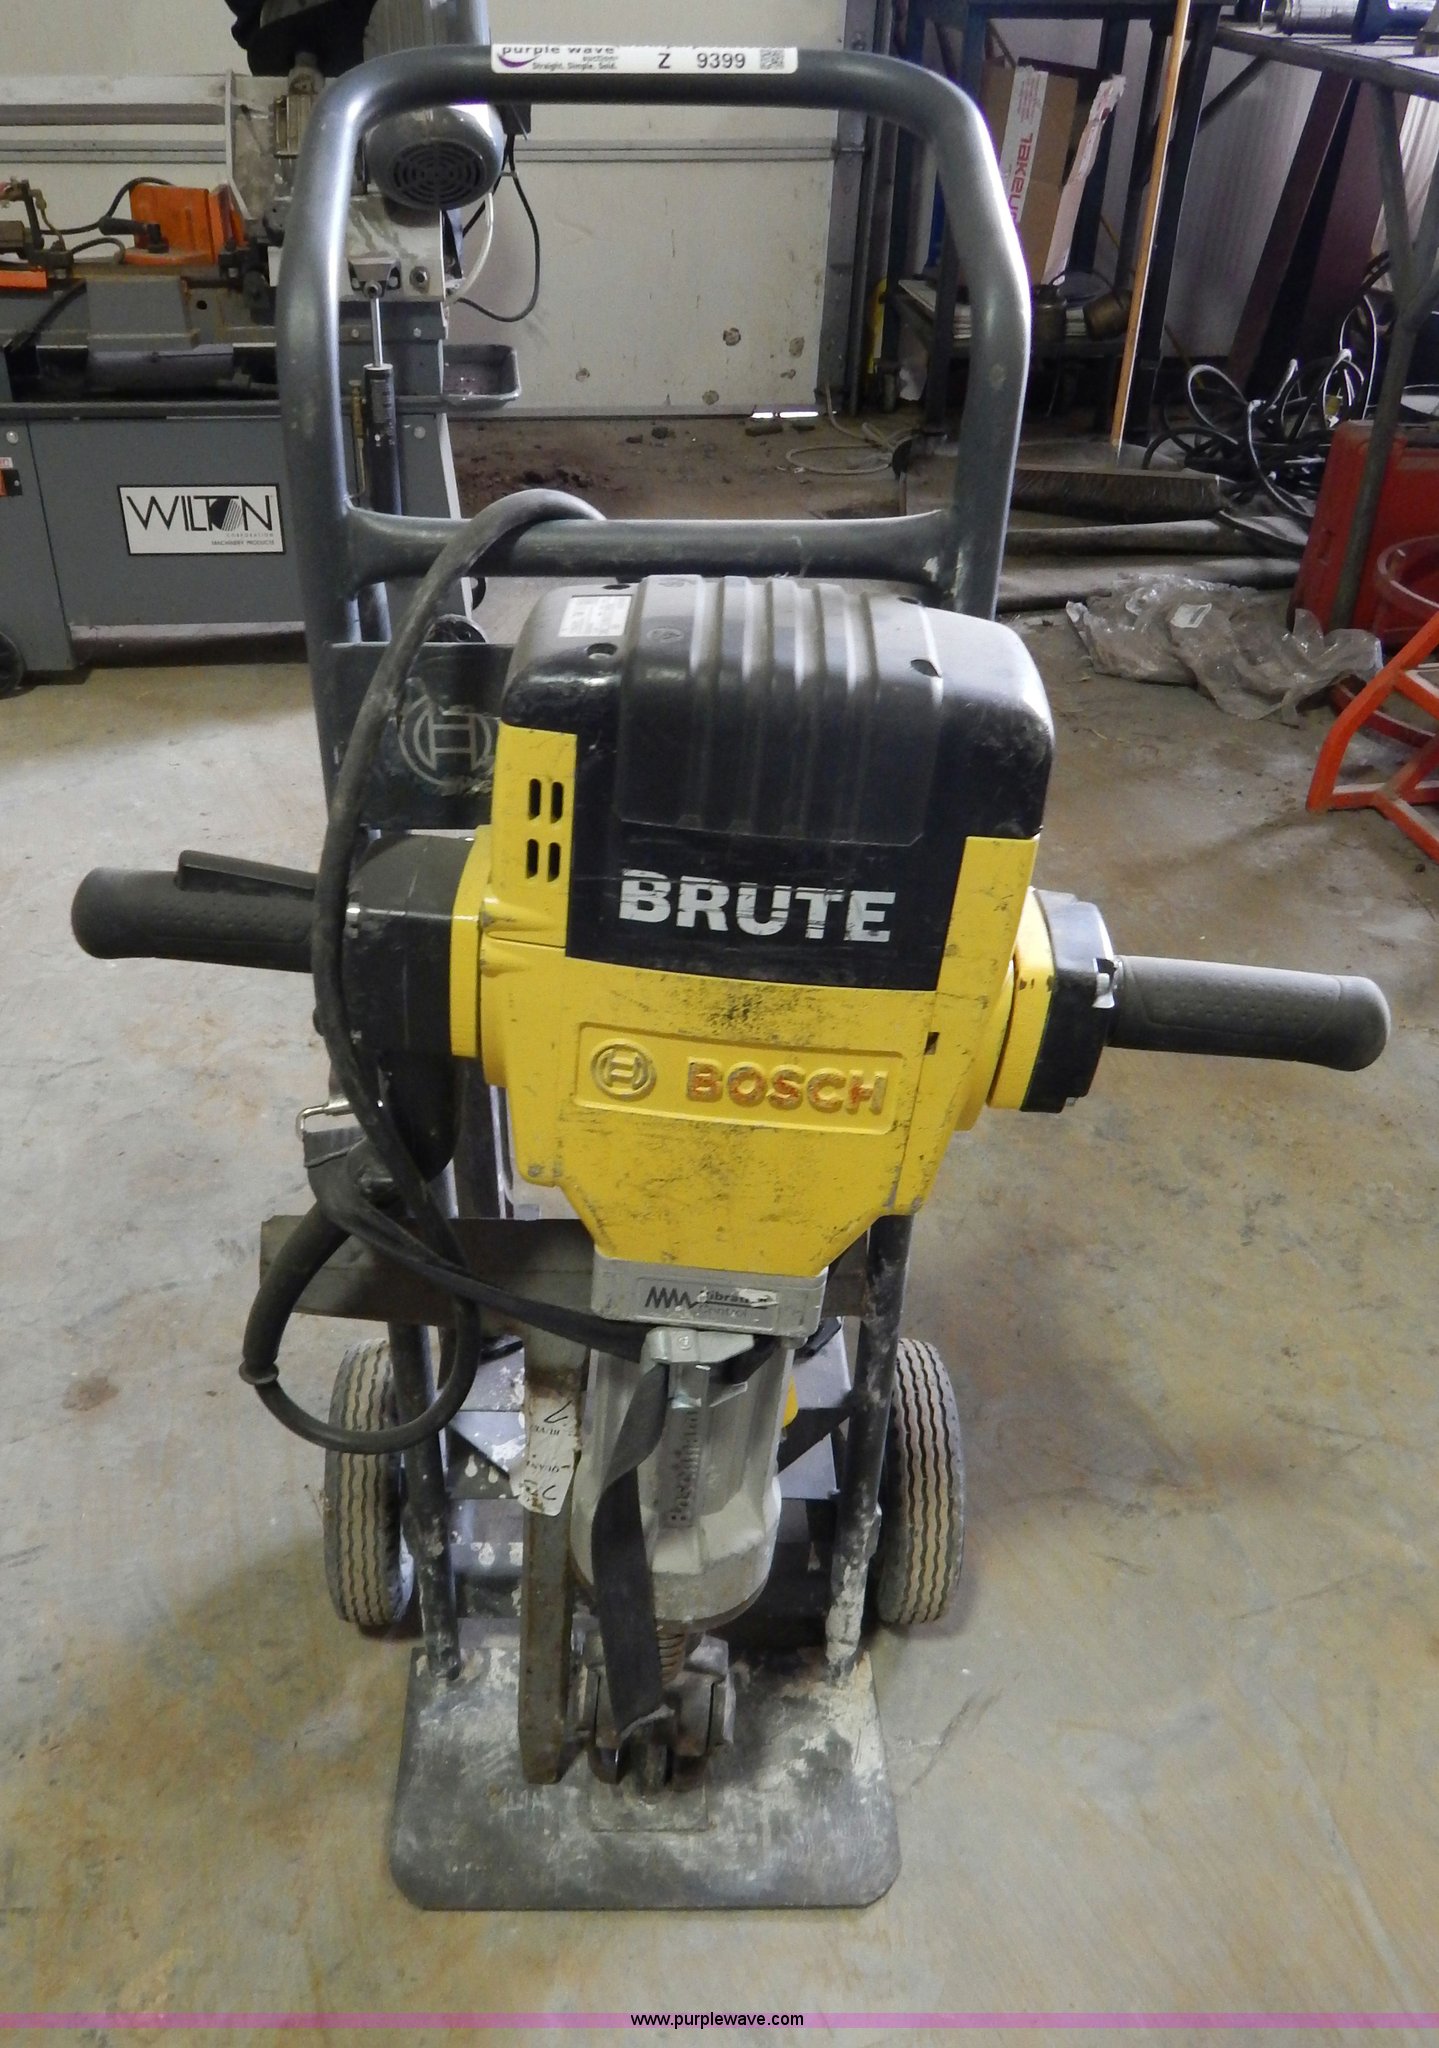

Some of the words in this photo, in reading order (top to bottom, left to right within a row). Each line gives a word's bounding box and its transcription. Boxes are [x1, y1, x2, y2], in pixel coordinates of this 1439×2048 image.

[658, 53, 671, 69] Z
[697, 53, 746, 69] 9399
[127, 494, 274, 532] WILTON
[619, 868, 896, 943] BRUTE
[686, 1055, 888, 1115] BOSCH
